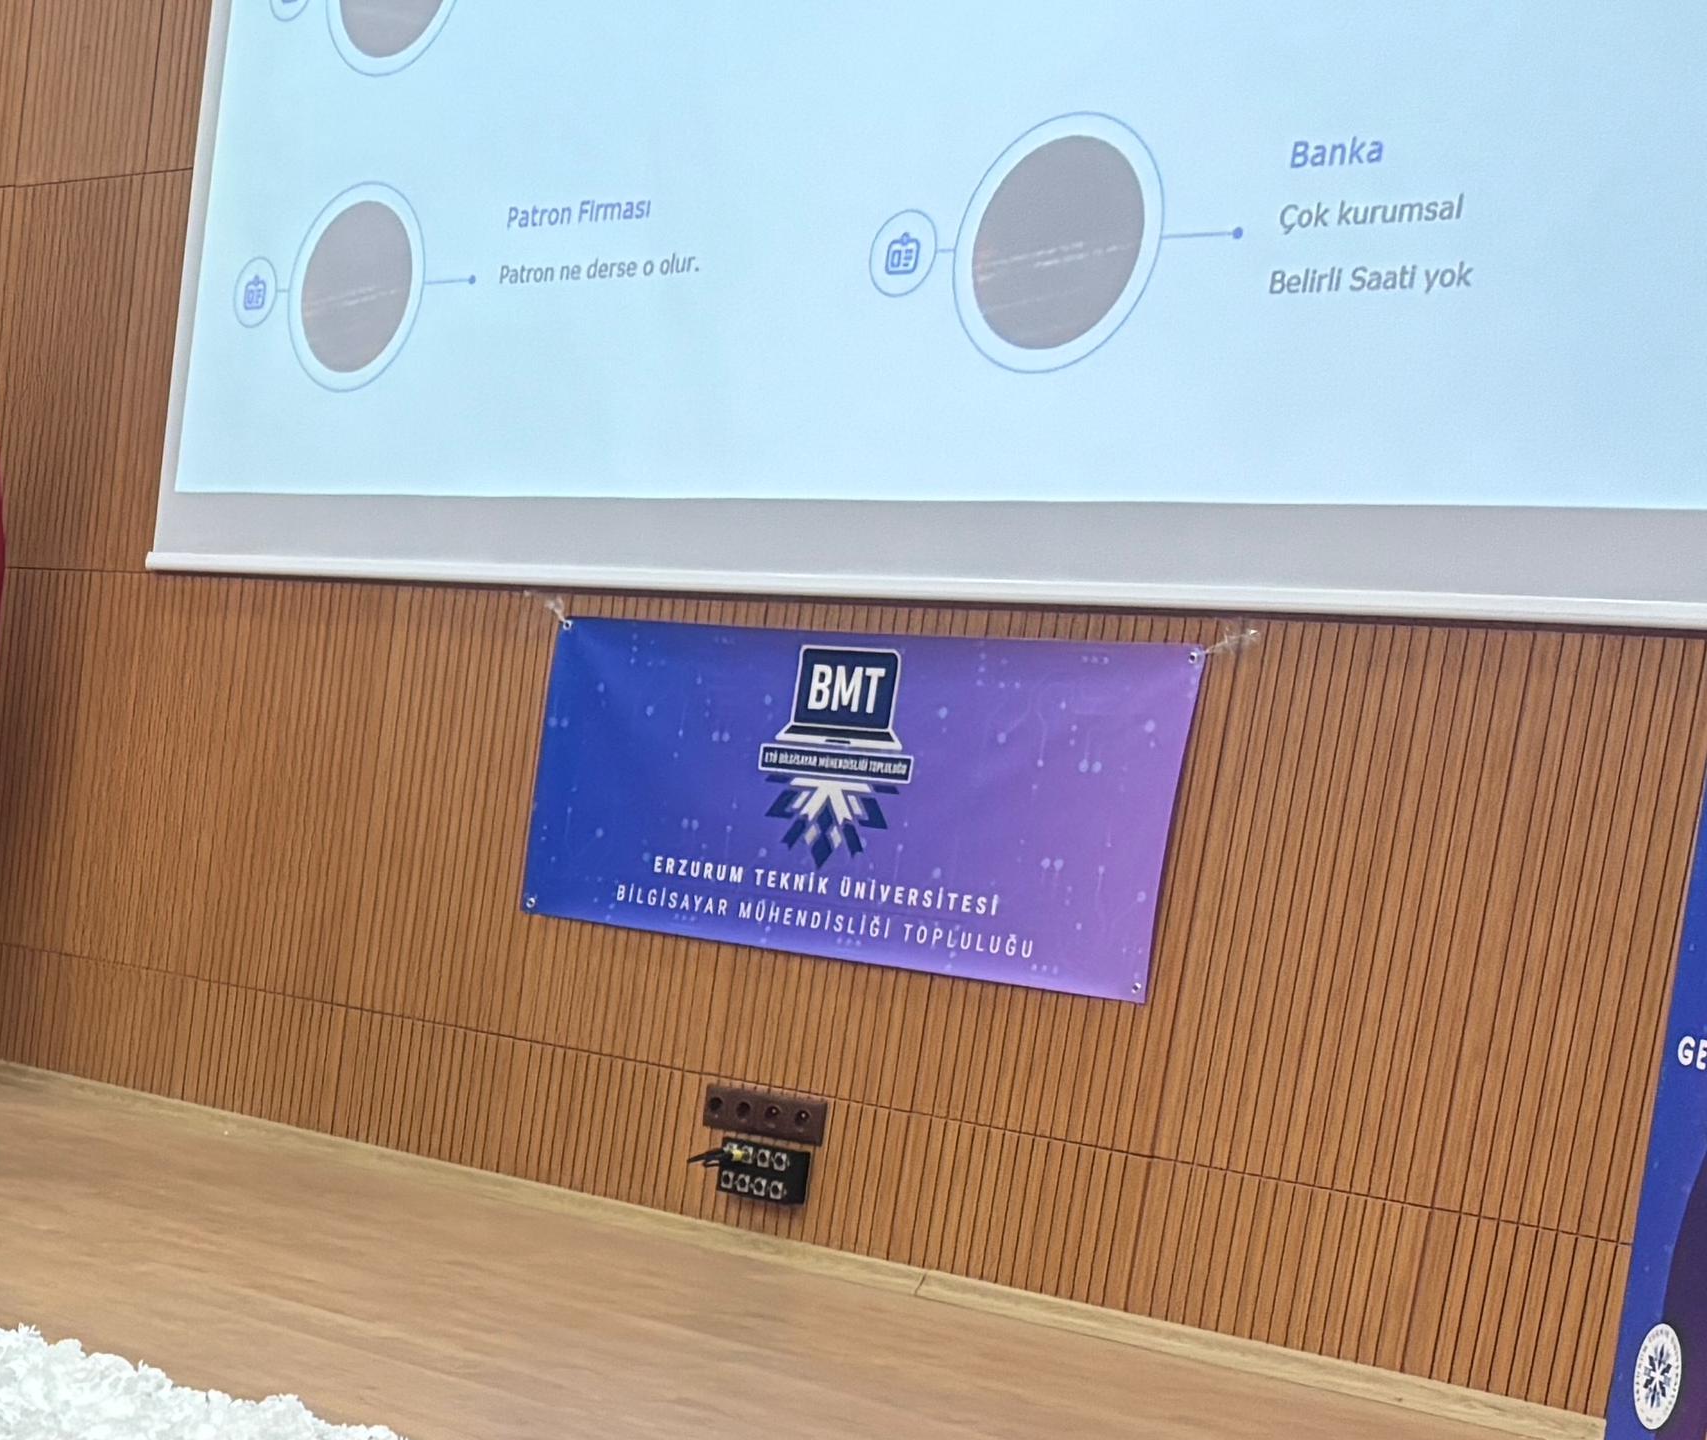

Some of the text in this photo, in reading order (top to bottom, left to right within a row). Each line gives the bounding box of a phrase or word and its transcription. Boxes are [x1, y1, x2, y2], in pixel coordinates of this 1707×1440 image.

[1290, 136, 1384, 169] Banka
[506, 199, 652, 229] Patron Firması
[1279, 192, 1465, 235] Çok kurumsal
[498, 252, 701, 284] Patron ne derse o olur.
[1268, 260, 1474, 294] Belirli Saati yok
[807, 664, 886, 714] BMT
[653, 855, 1000, 916] ERZURUM TEKNİK ÜNİVERSİTESİ
[616, 883, 1034, 959] BİLGİSAYAR MÜHENDİSLİĞİ TOPLULUĞU
